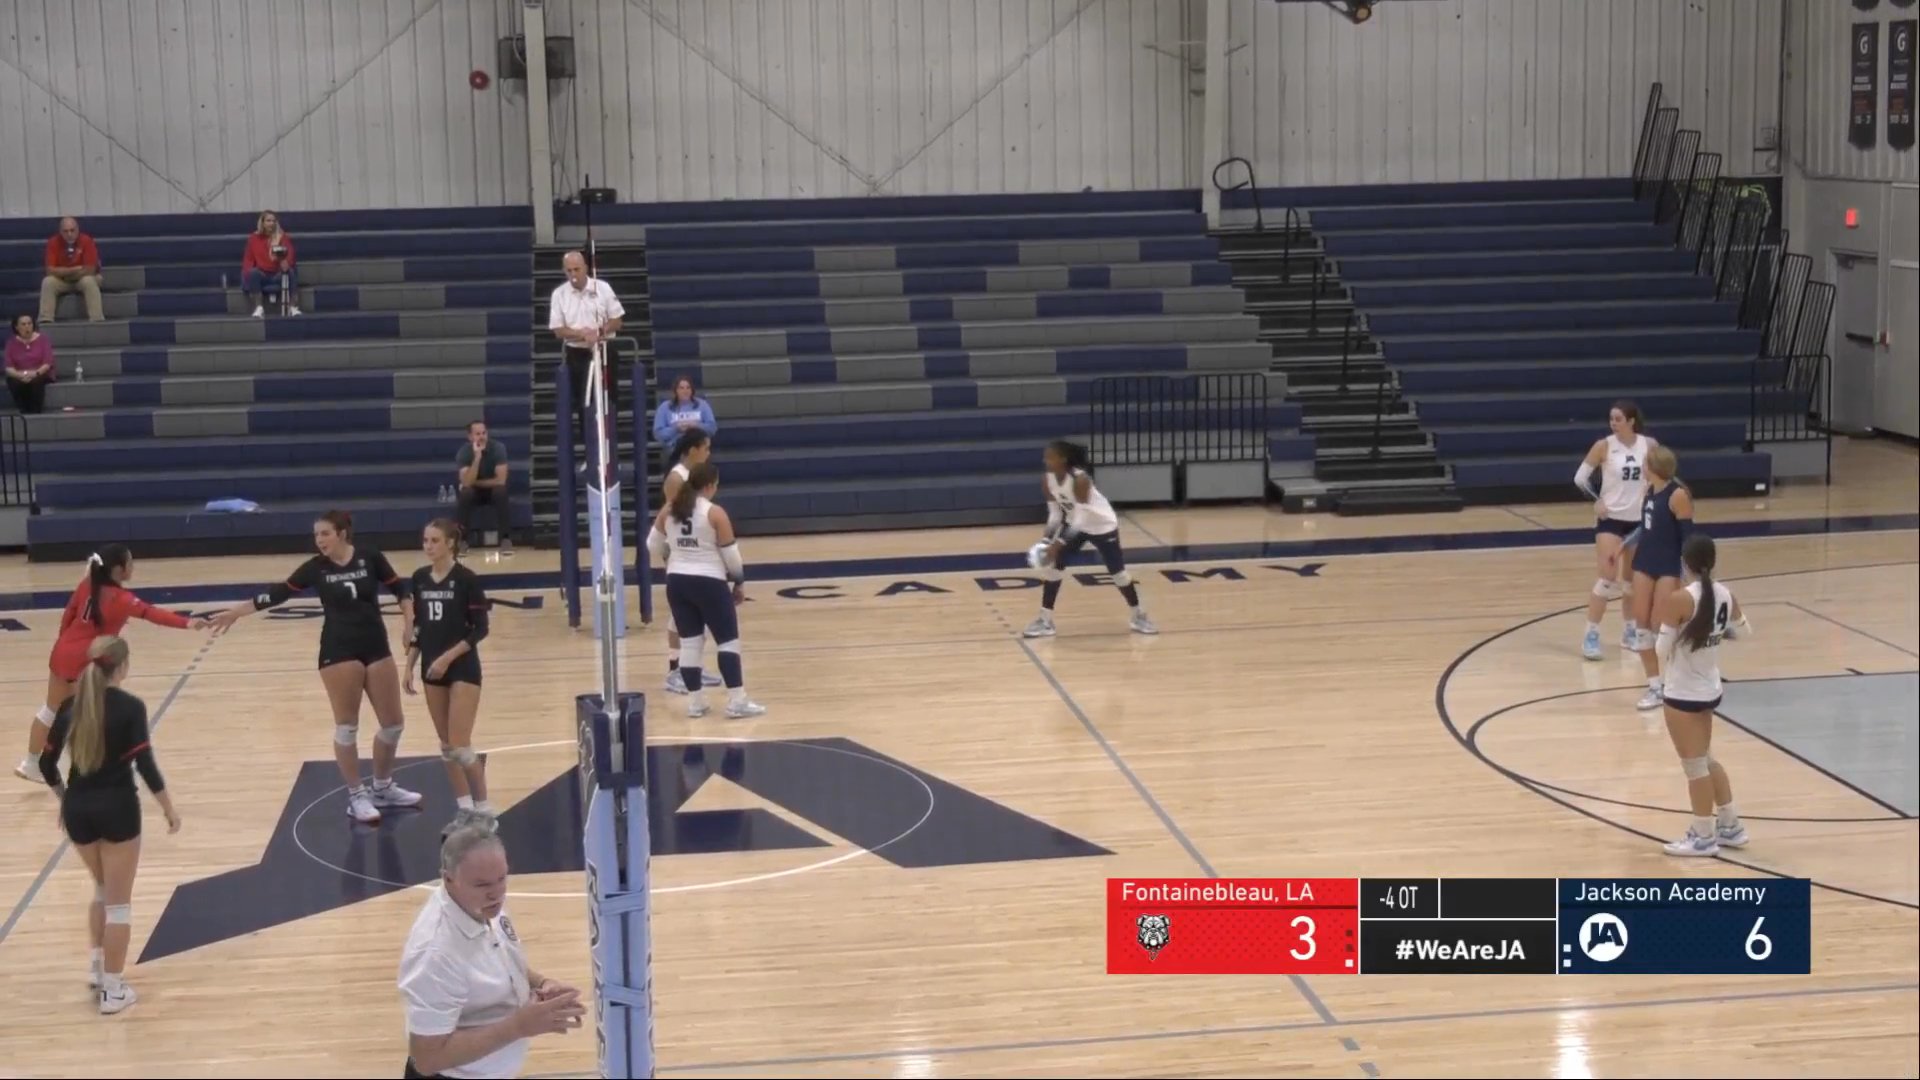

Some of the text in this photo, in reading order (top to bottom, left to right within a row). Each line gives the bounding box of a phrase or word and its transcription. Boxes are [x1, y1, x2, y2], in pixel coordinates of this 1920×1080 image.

[1622, 466, 1641, 481] 32
[681, 518, 693, 536] 5
[343, 581, 358, 599] 7
[428, 600, 443, 621] 19
